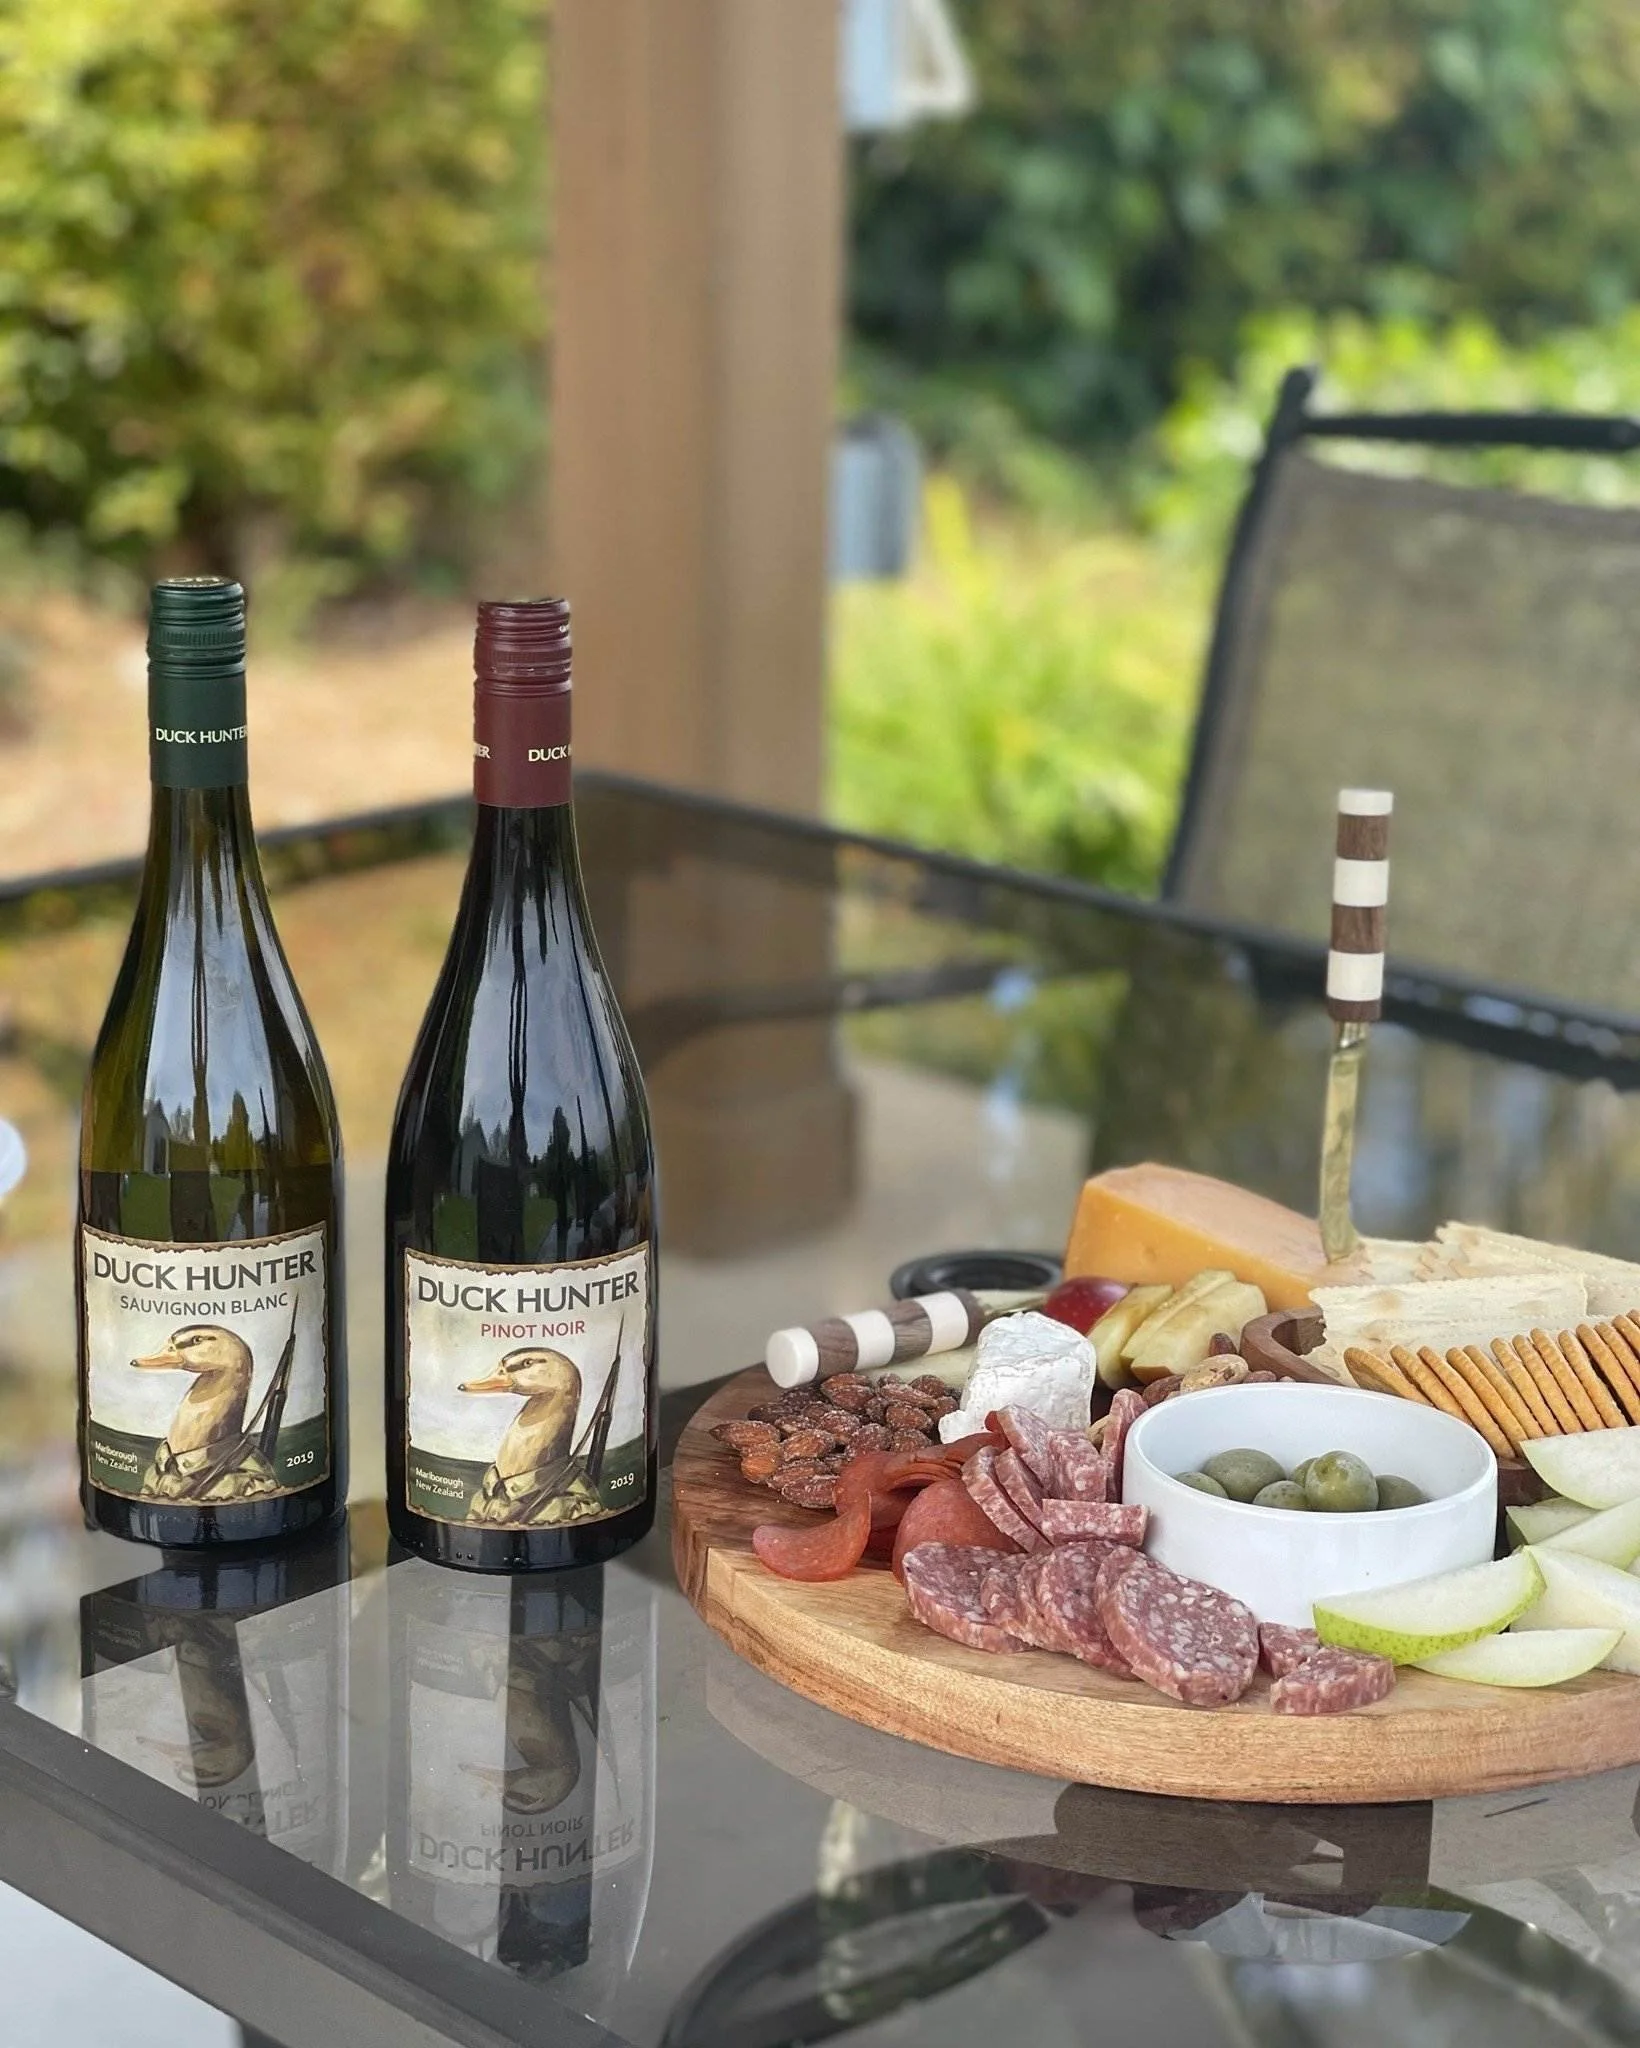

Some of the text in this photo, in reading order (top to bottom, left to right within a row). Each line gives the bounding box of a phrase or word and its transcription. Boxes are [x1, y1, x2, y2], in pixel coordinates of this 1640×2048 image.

[155, 727, 197, 744] DUCK
[528, 745, 567, 762] DUCK
[94, 1250, 317, 1291] DUCK HUNTER
[418, 1270, 639, 1313] DUCK HUNTER
[120, 1292, 288, 1316] SAUVIGNON BLANC
[481, 1320, 585, 1338] PINOT NOIR
[95, 1452, 138, 1474] New Zealand
[286, 1450, 314, 1468] 2019
[415, 1467, 464, 1489] Marlborough
[415, 1478, 464, 1499] New Zealand
[610, 1472, 634, 1490] 2019
